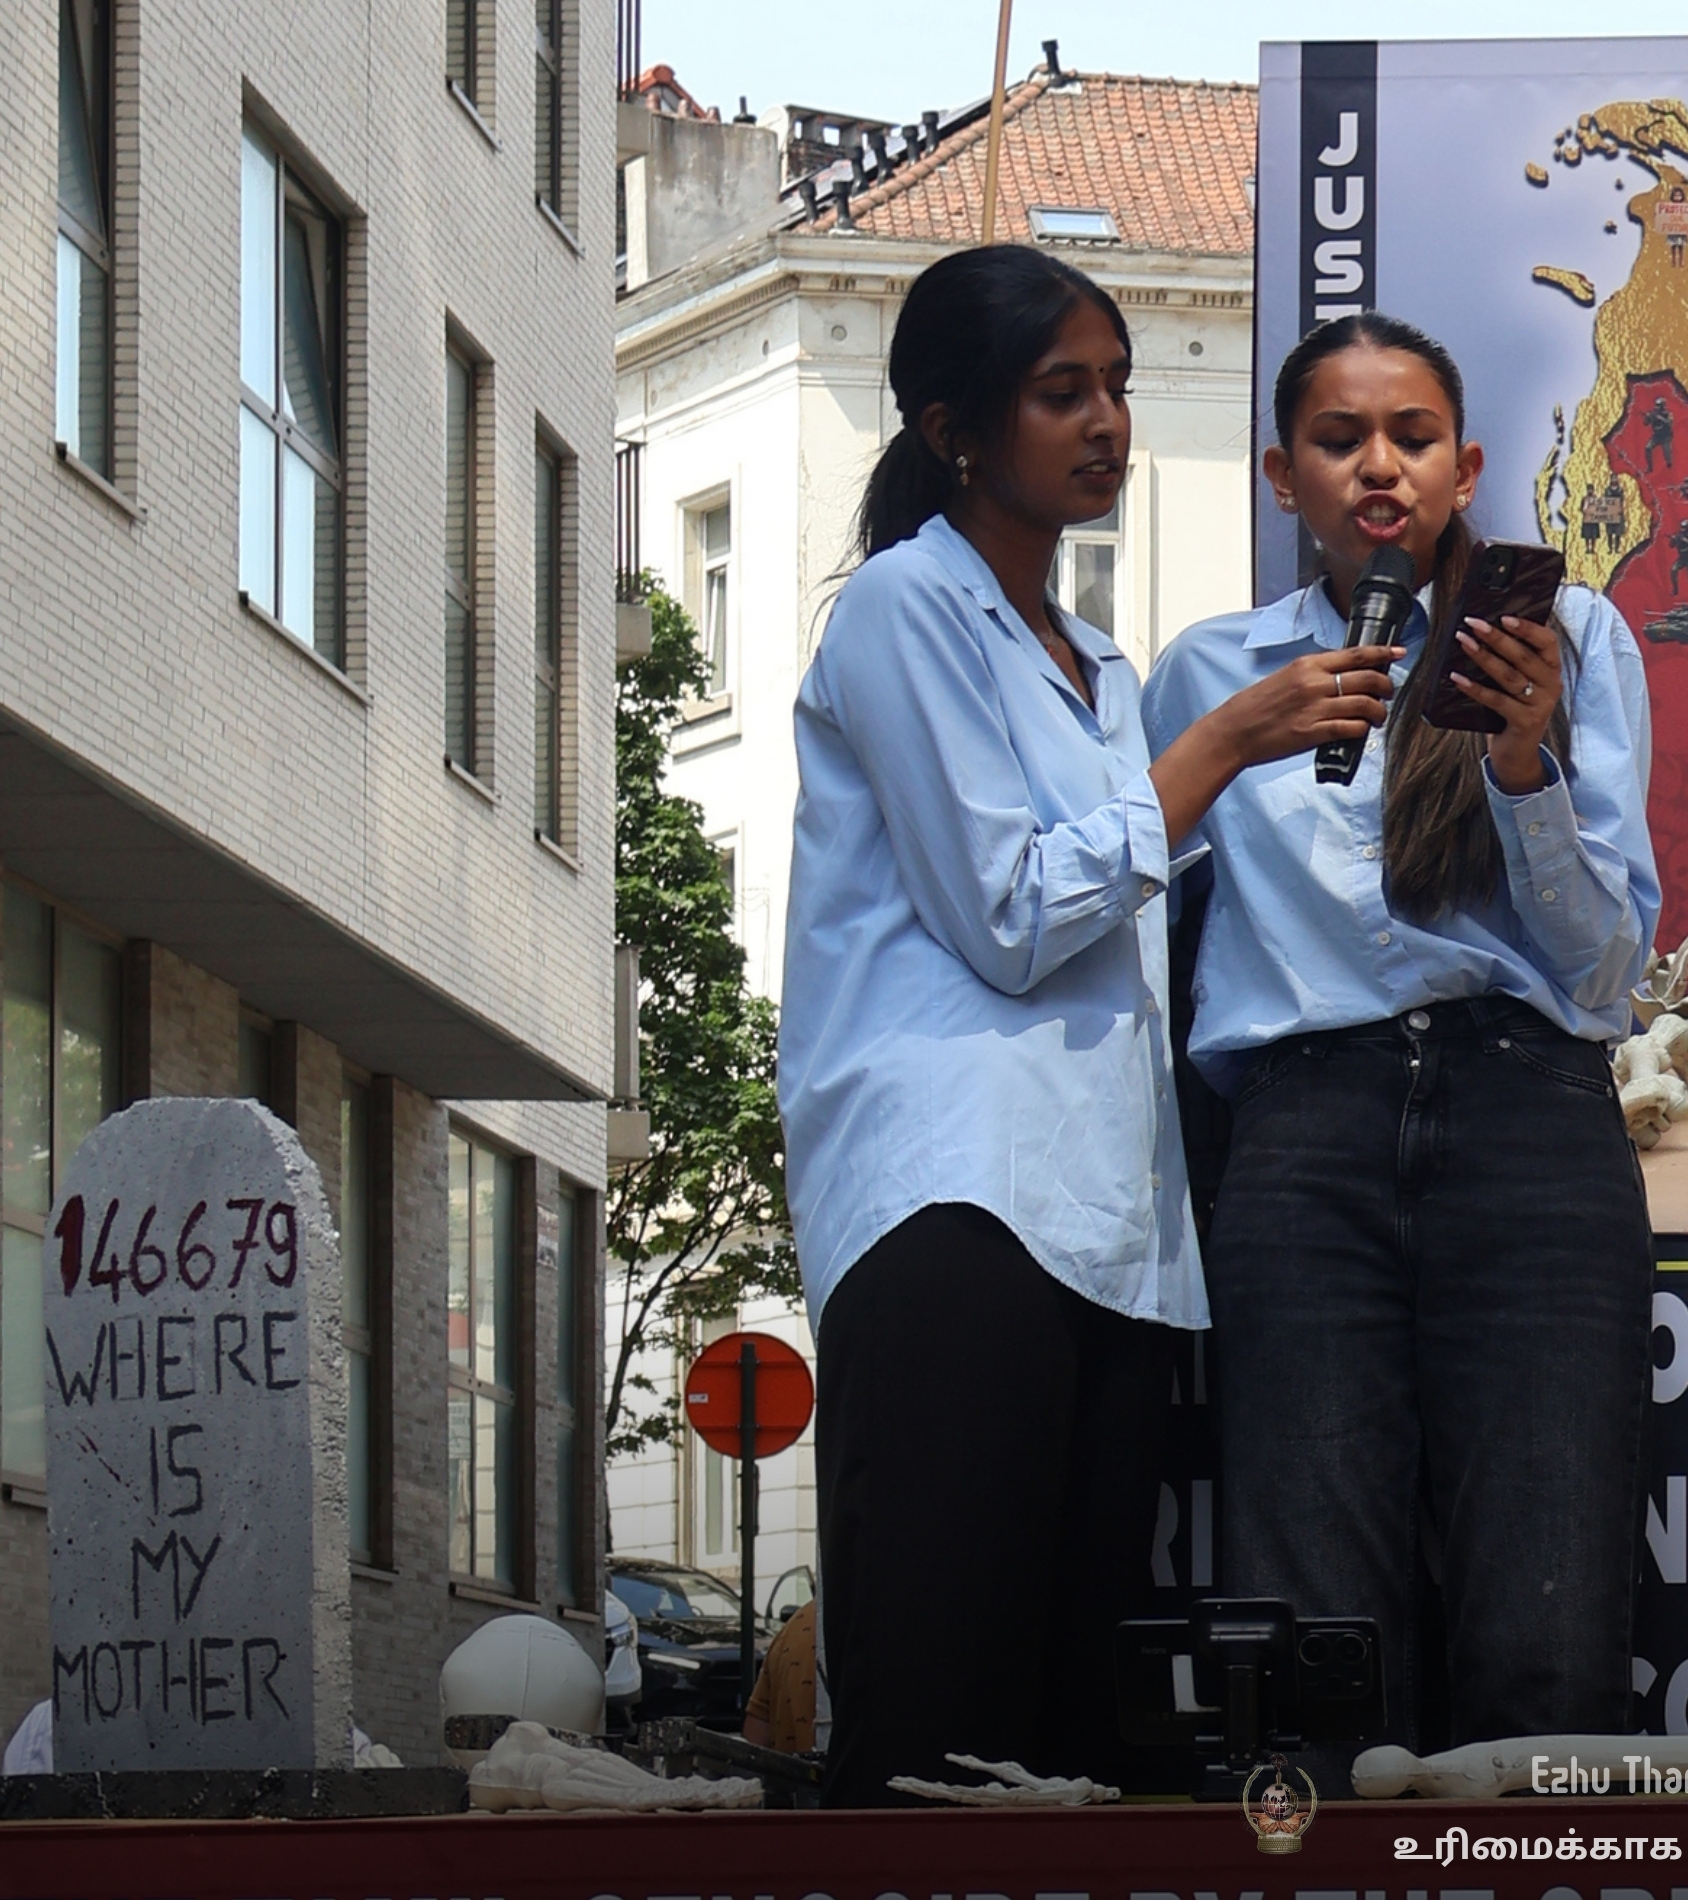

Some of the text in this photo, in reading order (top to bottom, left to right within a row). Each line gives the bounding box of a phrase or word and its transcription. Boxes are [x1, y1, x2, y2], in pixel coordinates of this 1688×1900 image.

[1313, 111, 1365, 320] JUS
[53, 1194, 300, 1304] 146679
[45, 1310, 302, 1406] WHERE
[149, 1424, 204, 1518] IS
[131, 1529, 222, 1626] MY
[52, 1636, 291, 1725] MOTHER
